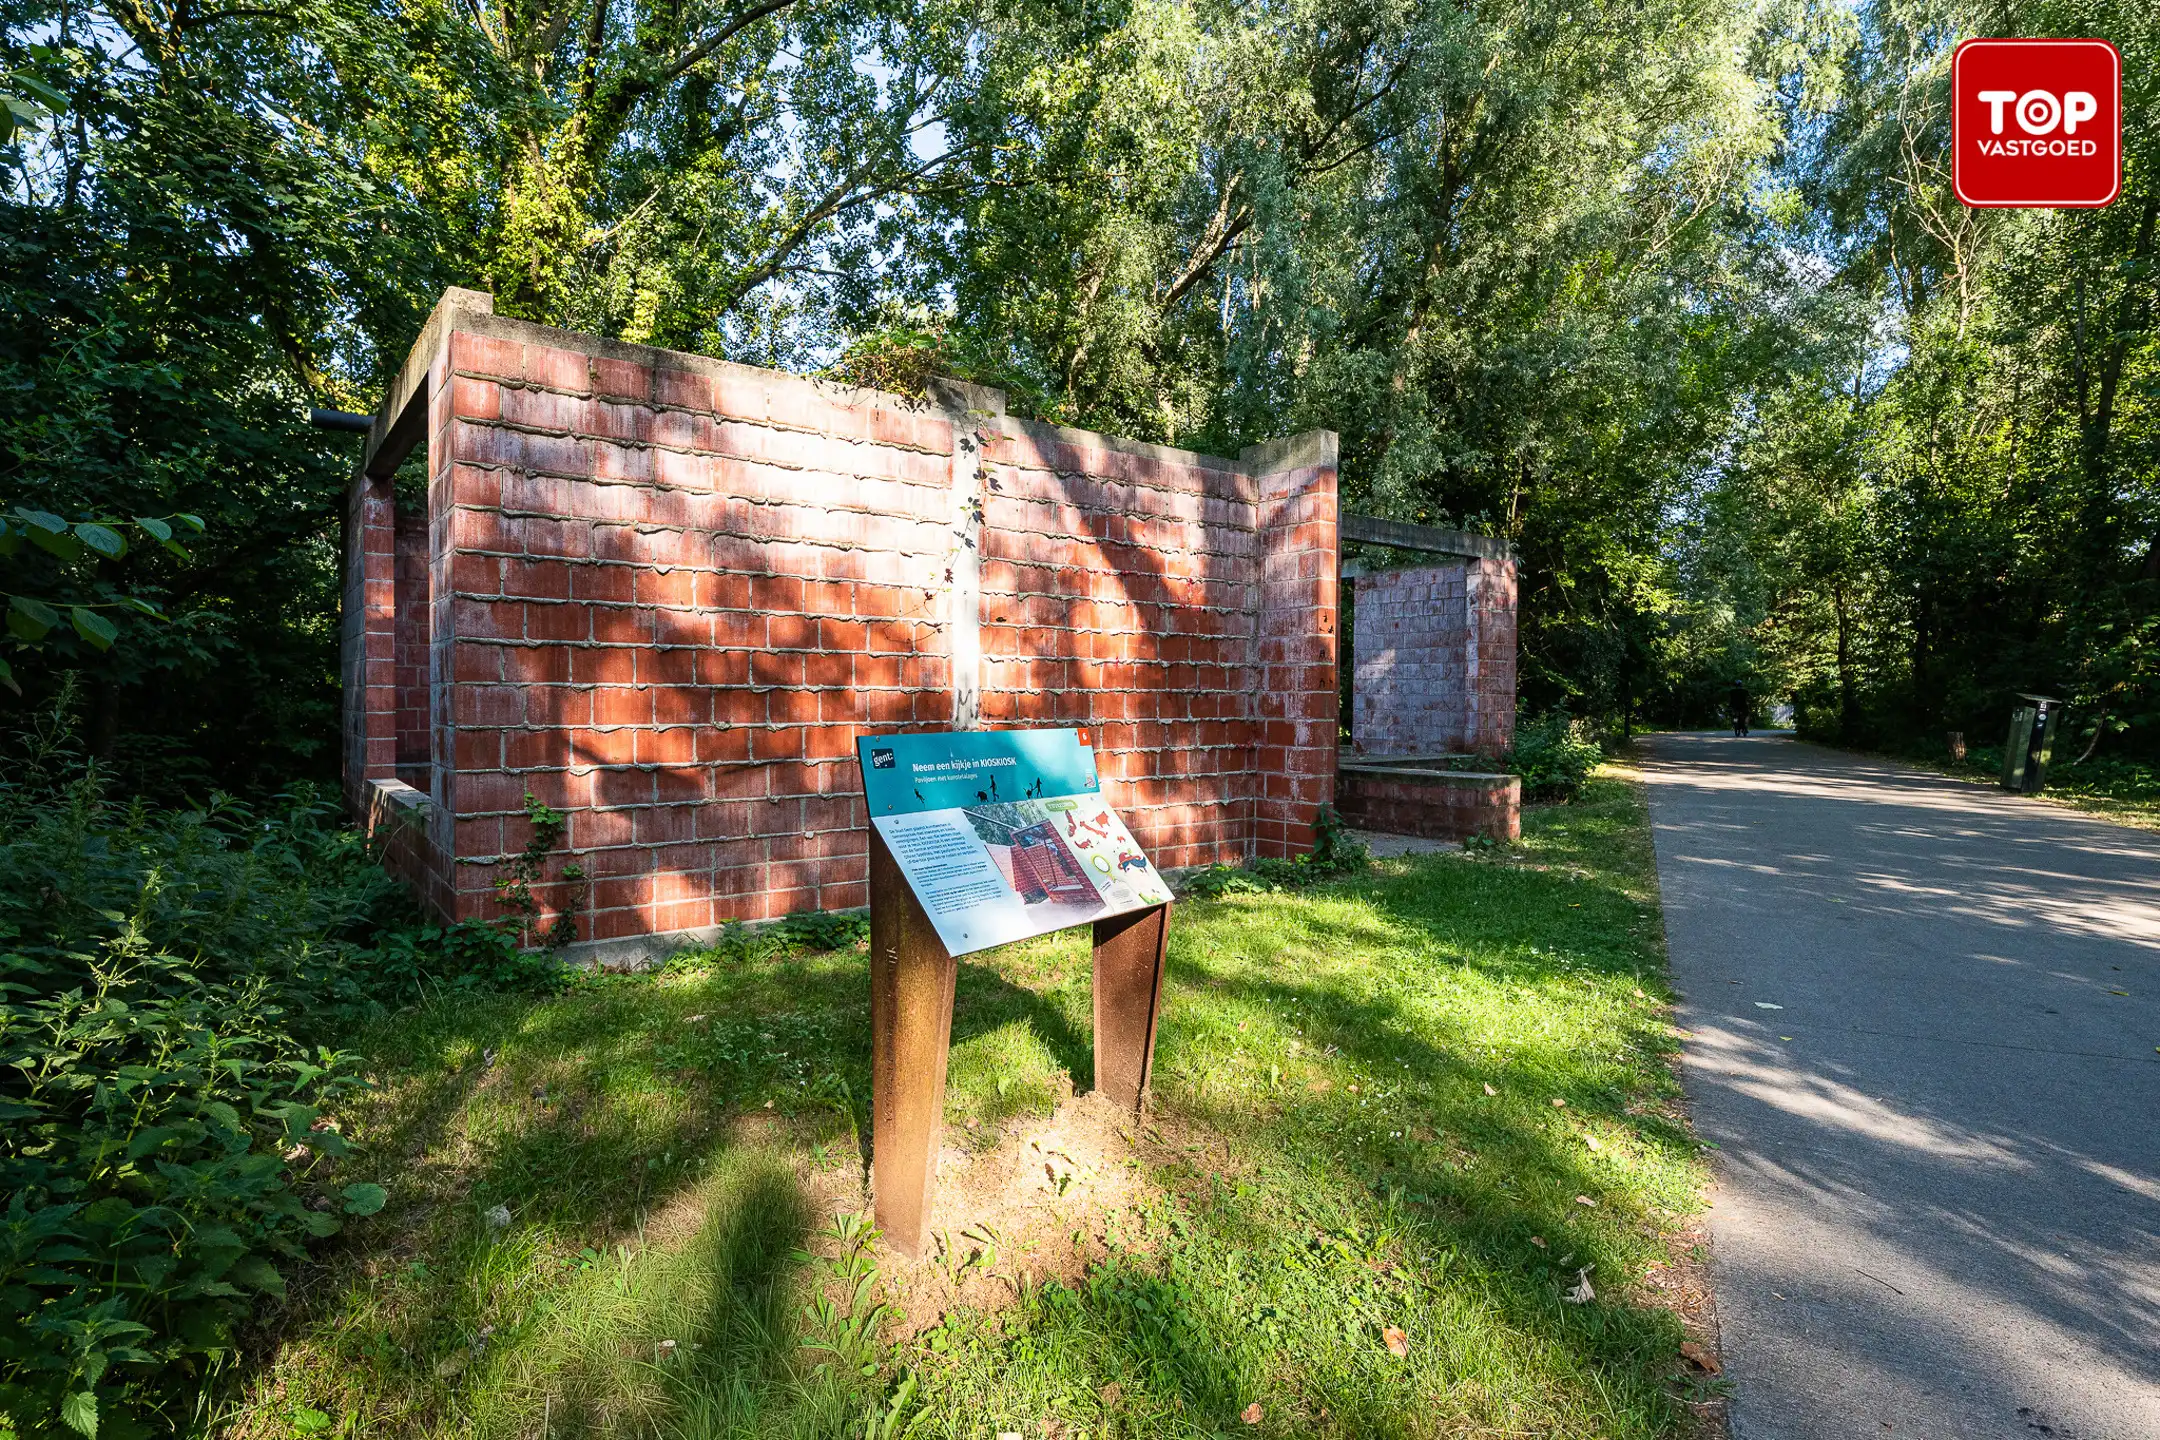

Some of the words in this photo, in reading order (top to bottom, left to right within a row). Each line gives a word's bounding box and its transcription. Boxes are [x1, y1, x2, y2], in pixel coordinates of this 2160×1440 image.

[1082, 732, 1088, 741] 6
[912, 763, 935, 772] Neem
[936, 761, 950, 770] een
[951, 759, 971, 771] kijkje
[972, 758, 980, 768] in
[980, 757, 1017, 768] KIOSKIOSK
